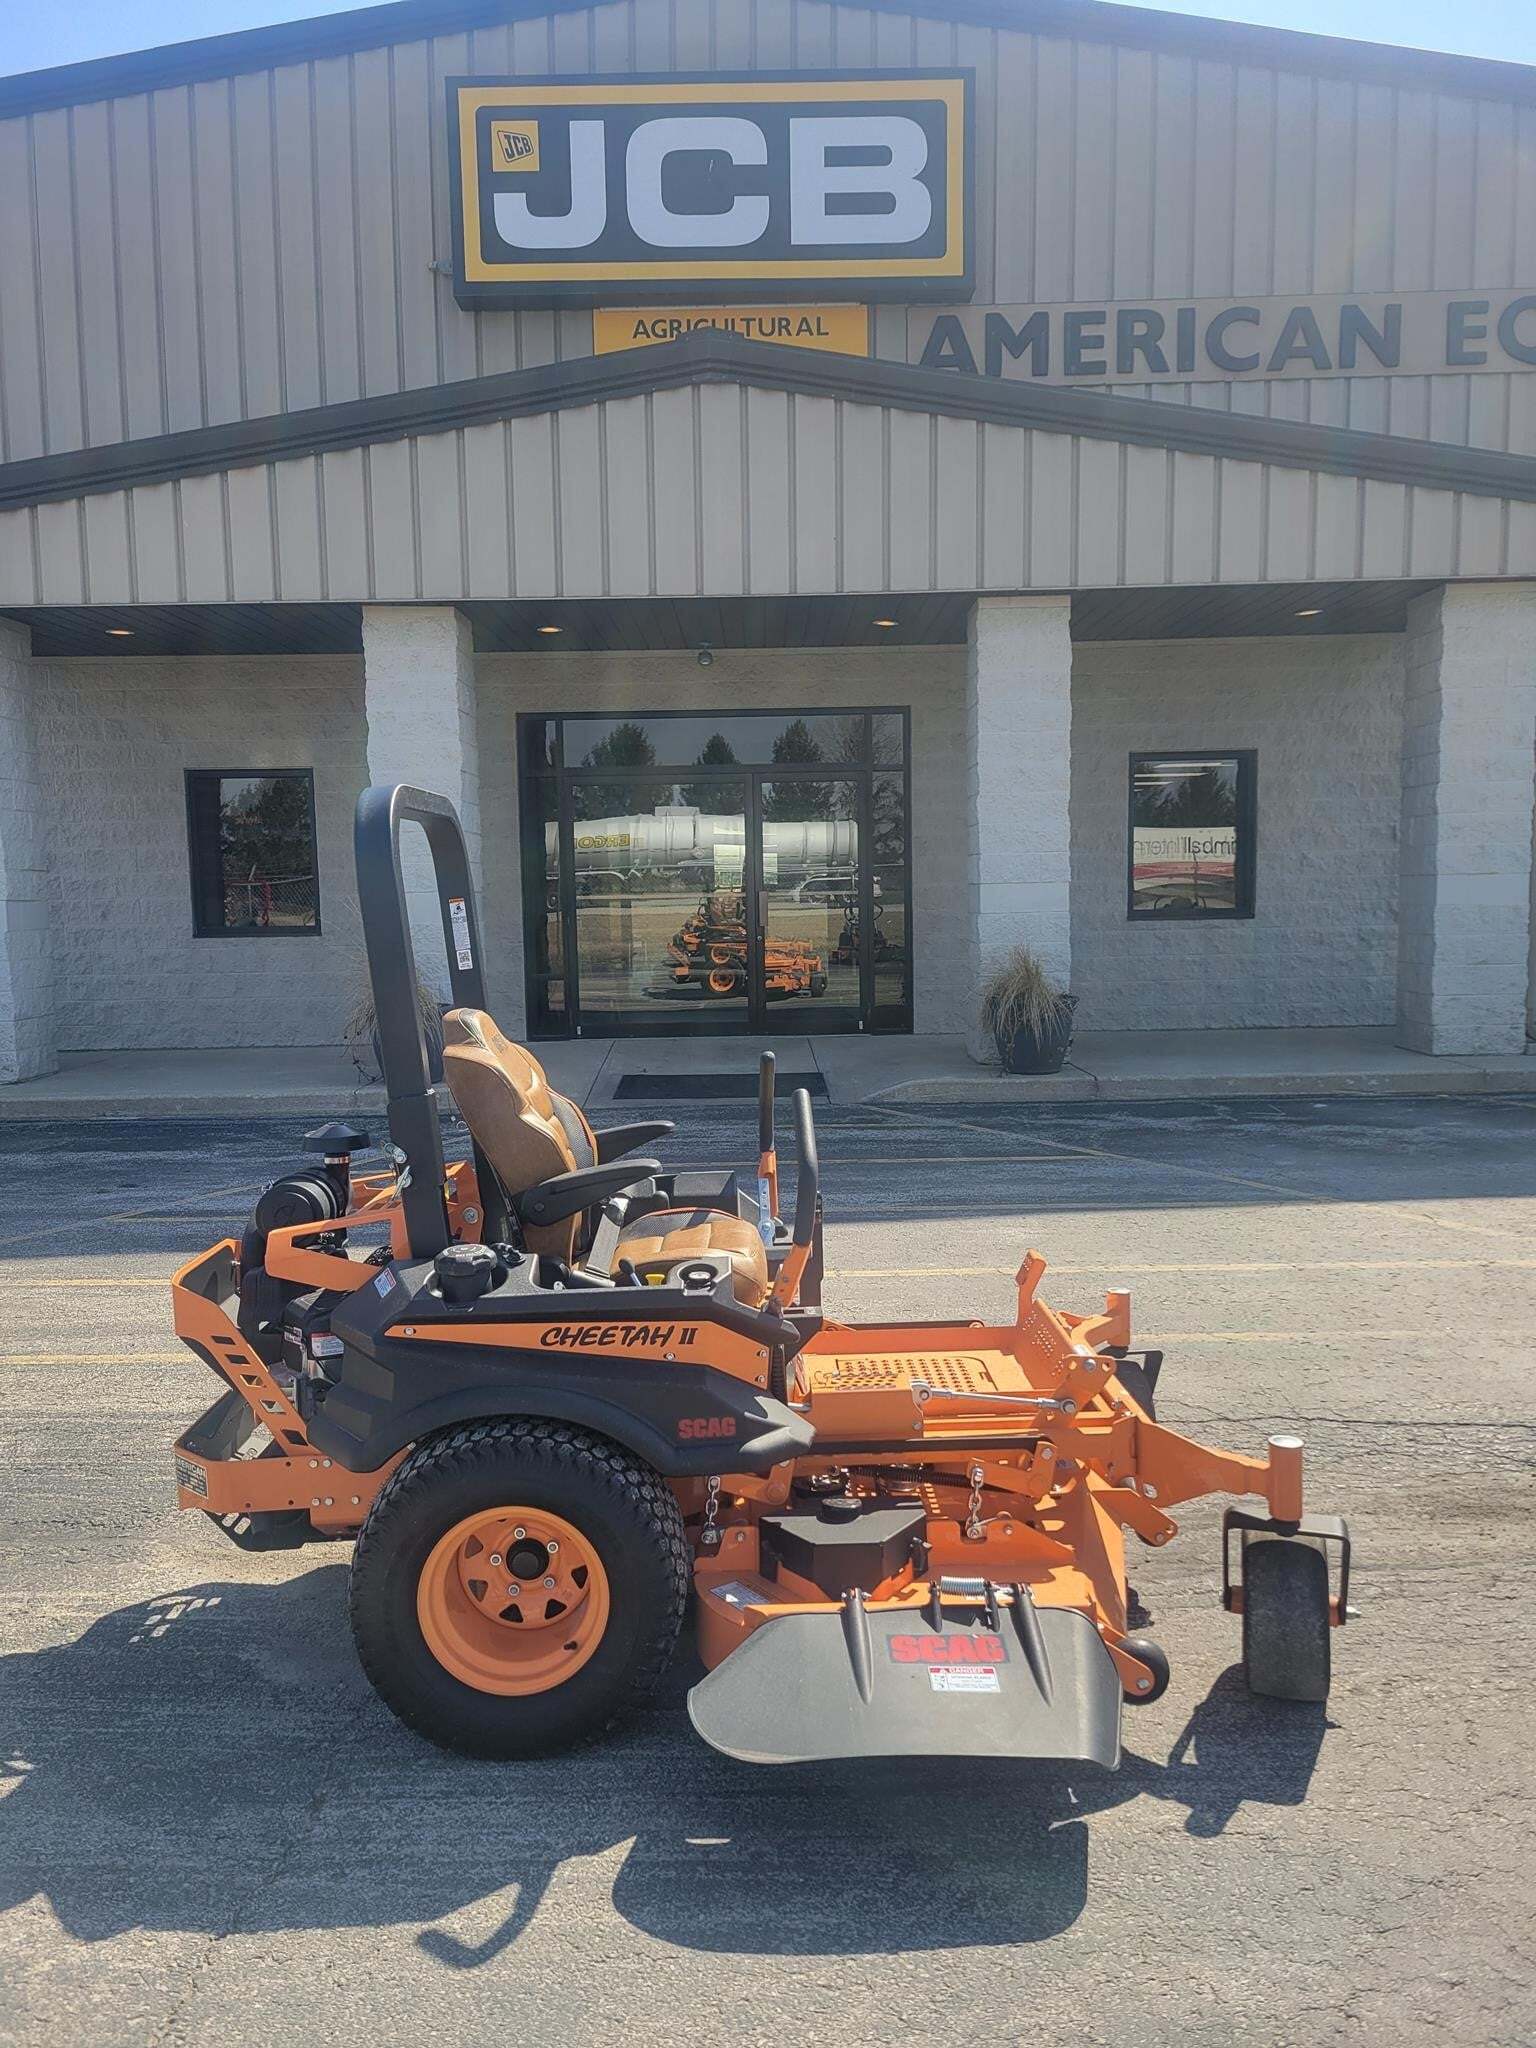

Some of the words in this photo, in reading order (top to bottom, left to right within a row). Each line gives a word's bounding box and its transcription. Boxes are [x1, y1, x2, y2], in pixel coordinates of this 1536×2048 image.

[504, 133, 532, 160] JCB
[493, 115, 933, 249] JCB
[918, 303, 1402, 377] AMERICAN
[540, 1324, 676, 1347] CHEETAH
[678, 1326, 699, 1345] II
[677, 1416, 737, 1438] SCAG
[891, 1633, 1004, 1662] SCAG
